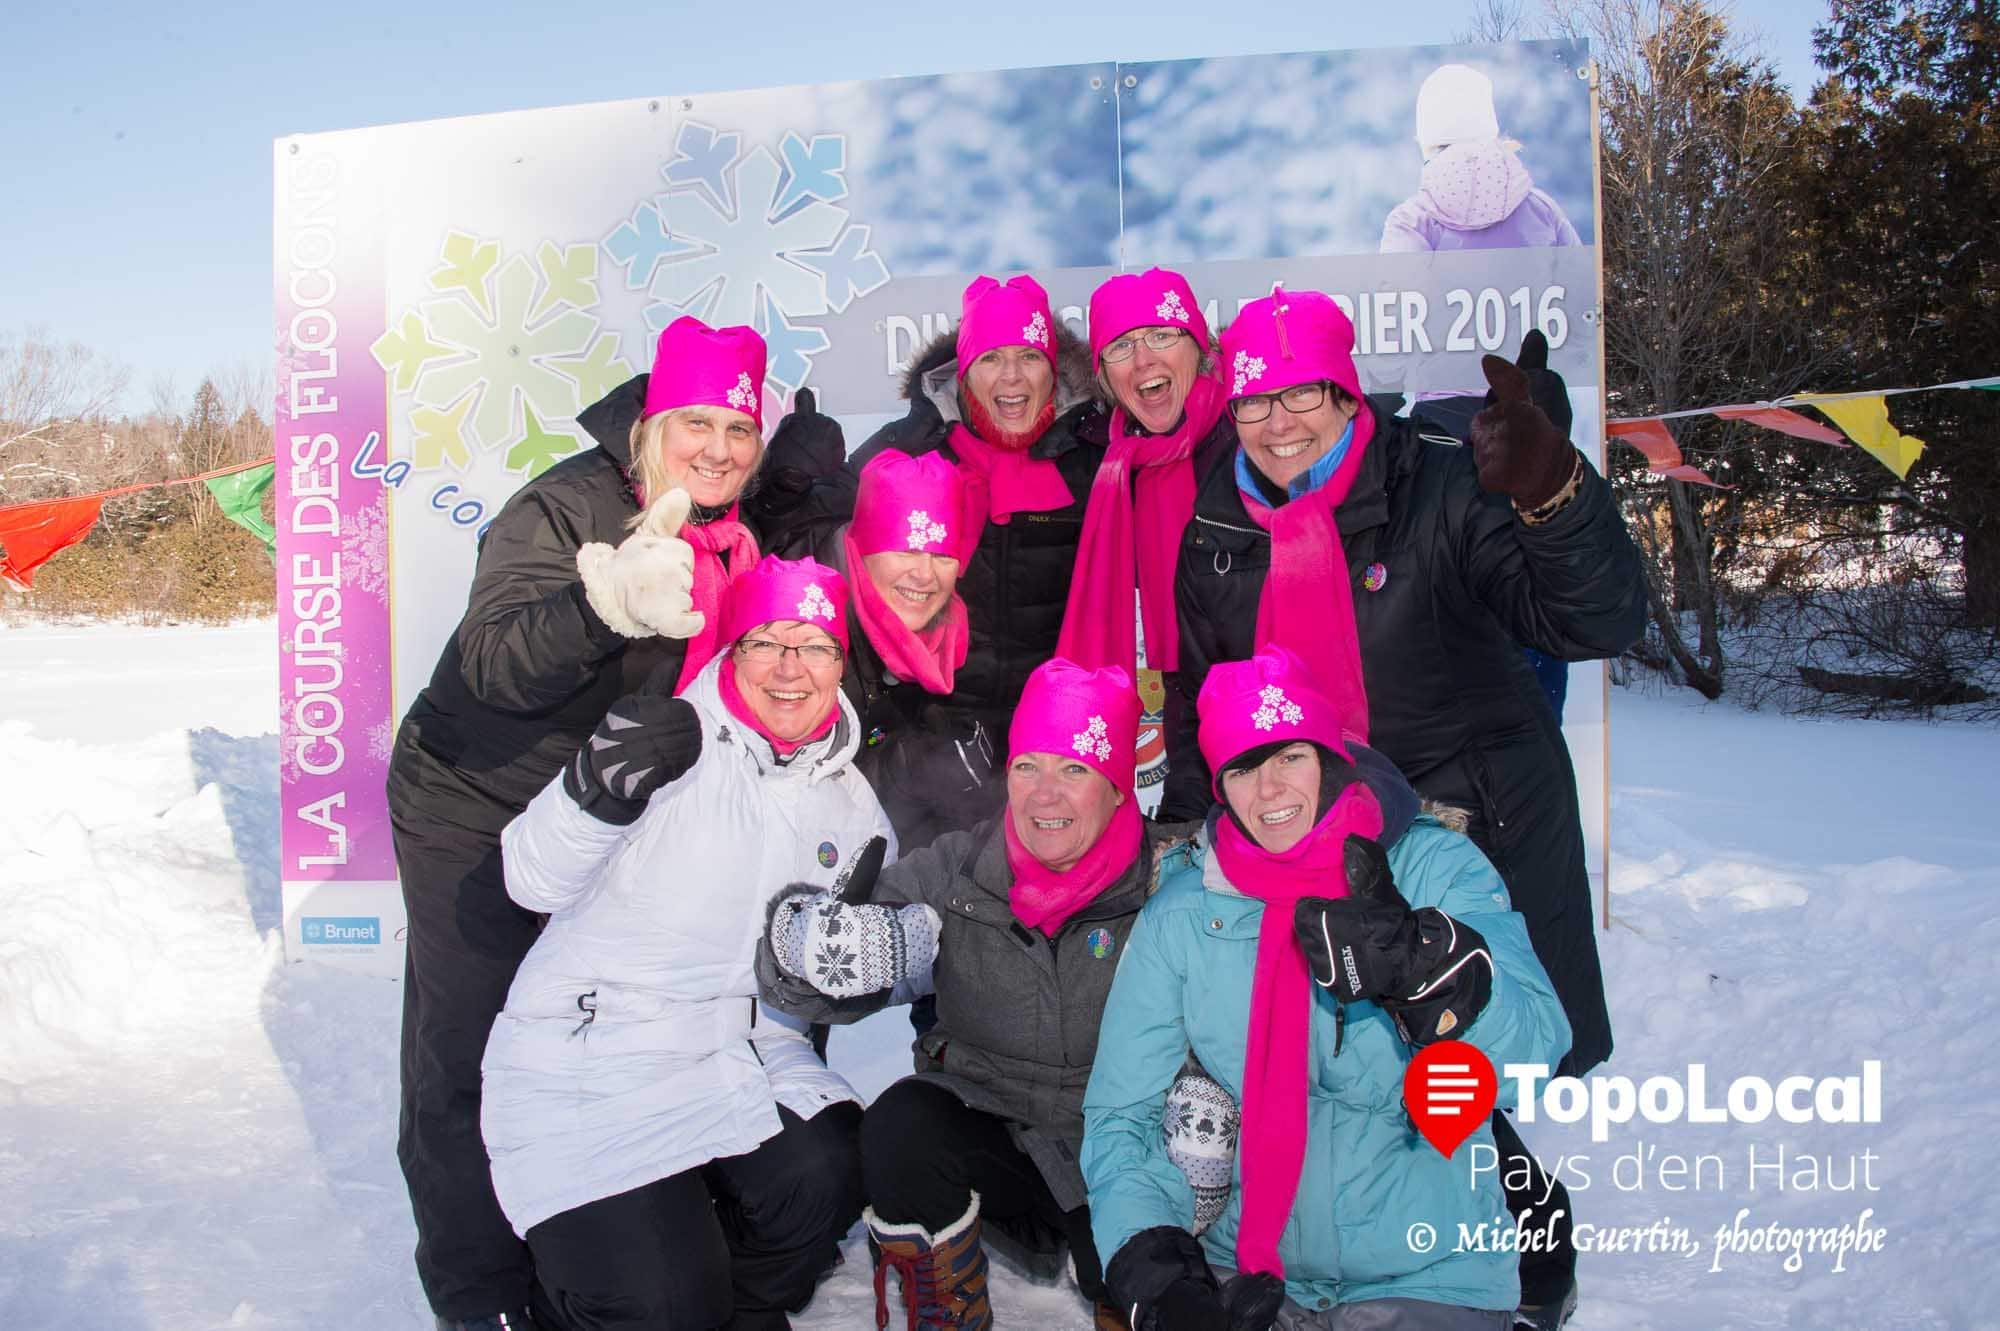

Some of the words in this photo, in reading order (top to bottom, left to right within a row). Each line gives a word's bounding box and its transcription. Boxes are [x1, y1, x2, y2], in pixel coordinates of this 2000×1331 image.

[289, 152, 339, 420] FLOCONS
[1446, 285, 1568, 351] 2016
[290, 433, 340, 537] DES
[351, 432, 413, 490] La
[430, 484, 494, 541] co
[292, 551, 345, 776] COURSE
[298, 791, 347, 870] LA
[325, 924, 376, 939] Brunet
[1341, 945, 1363, 996] TERRA
